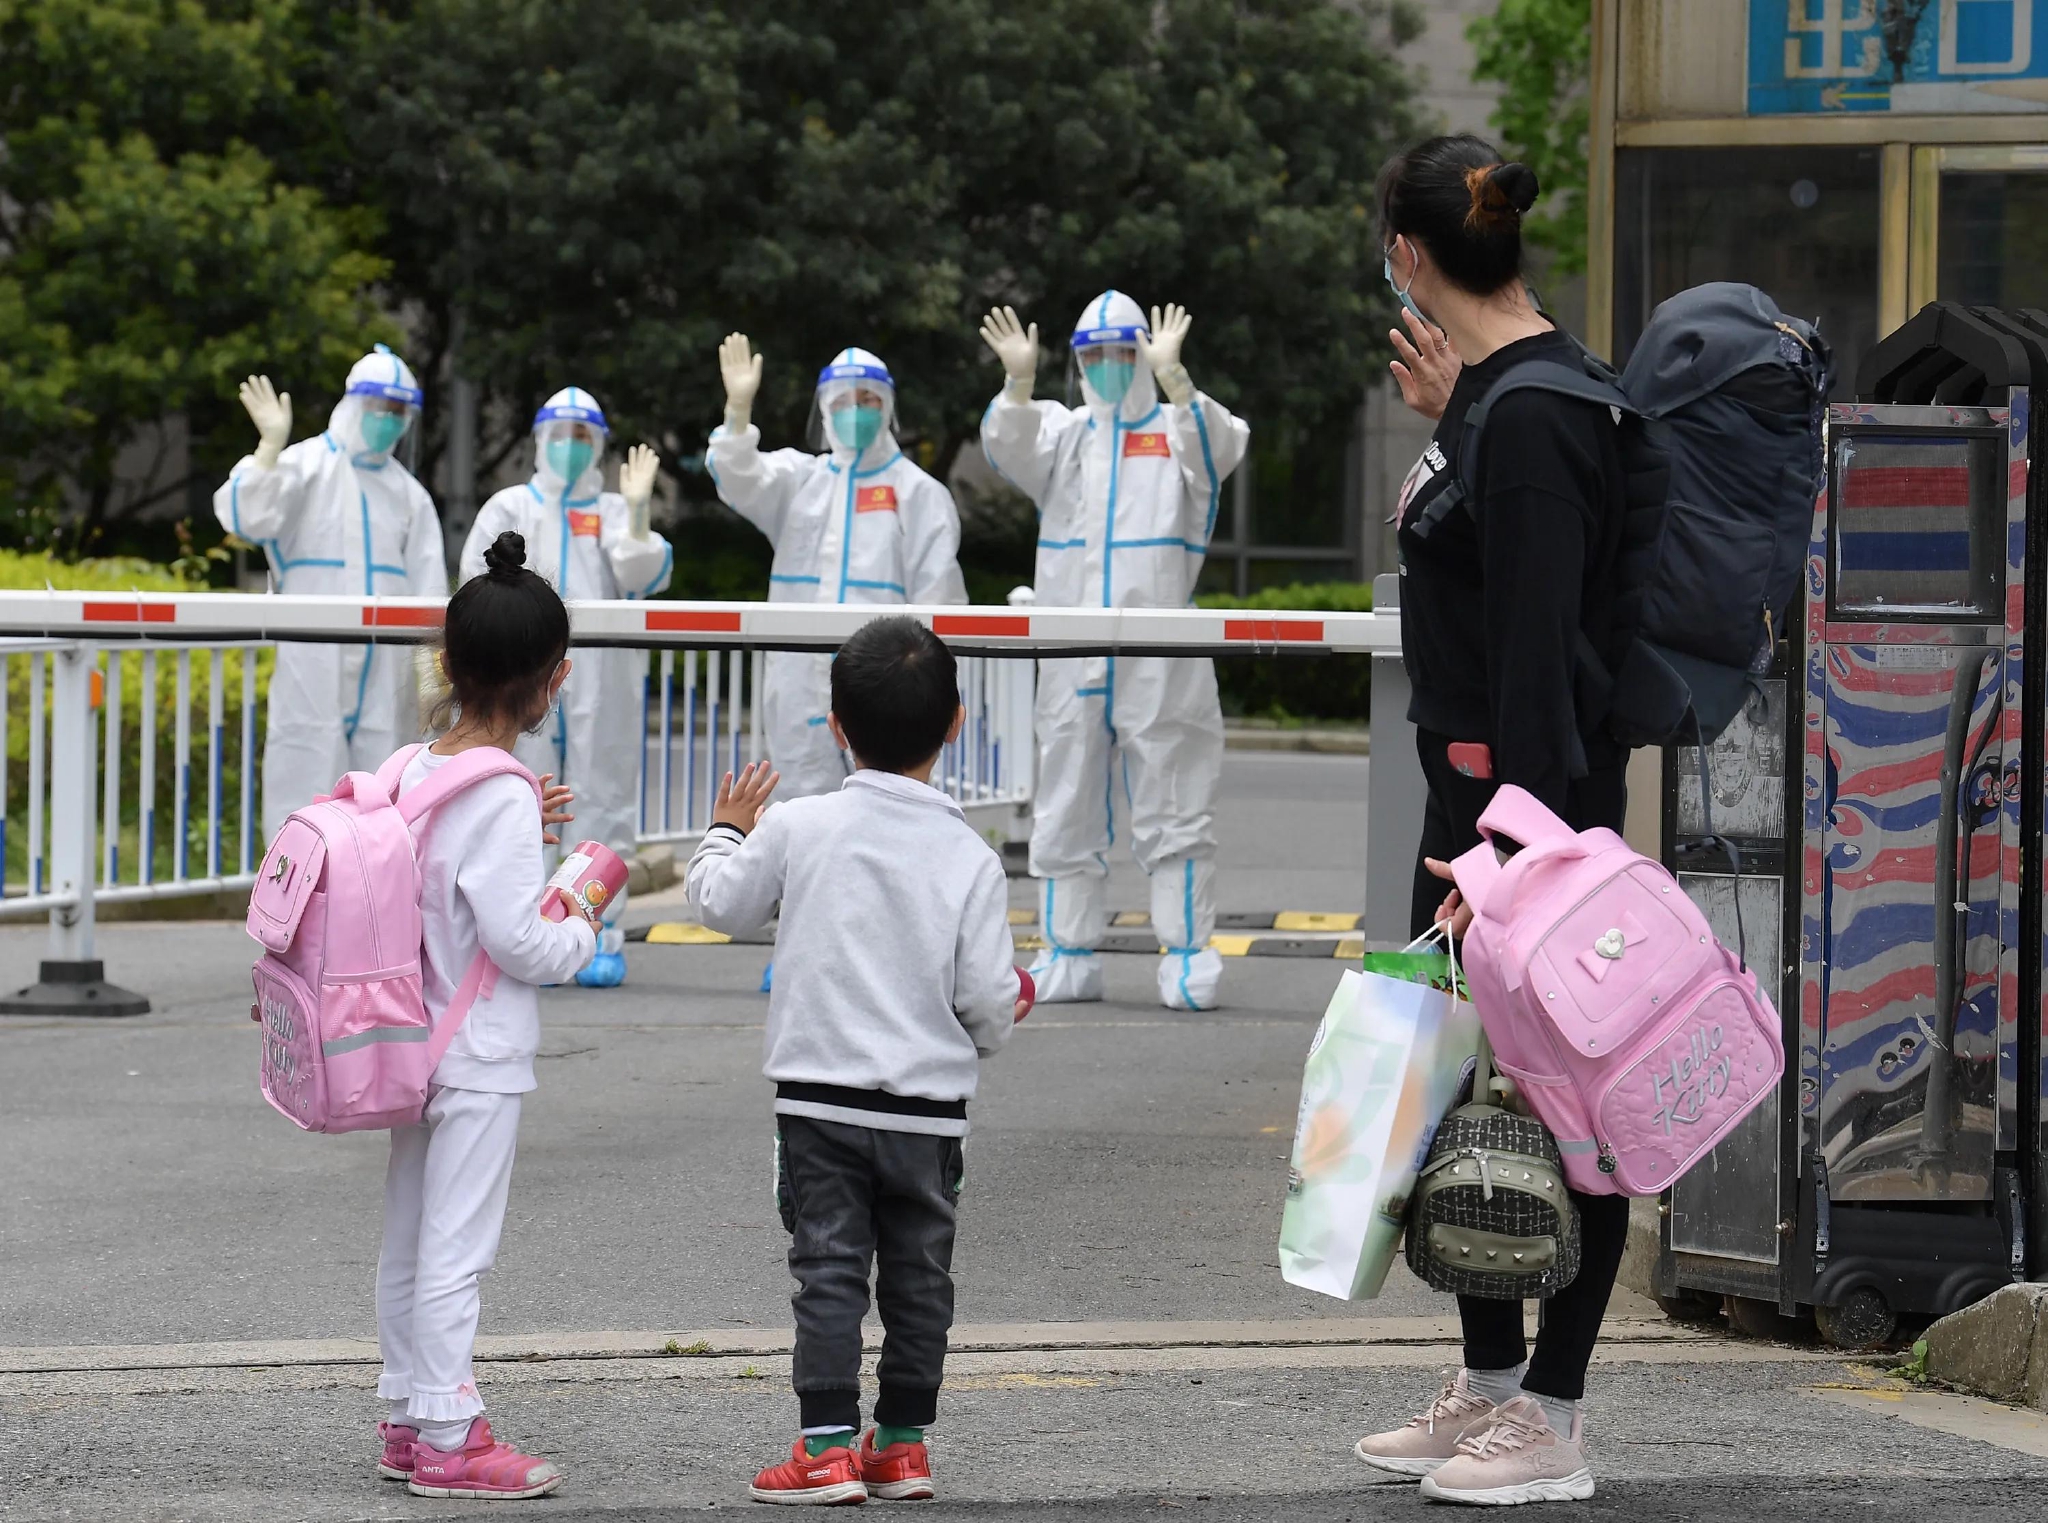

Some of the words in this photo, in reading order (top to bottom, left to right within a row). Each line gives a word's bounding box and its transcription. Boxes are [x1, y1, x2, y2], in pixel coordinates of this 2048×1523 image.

[1784, 0, 2032, 78] 出口
[265, 994, 294, 1043] Hello
[1652, 1024, 1724, 1106] Hello
[1652, 1055, 1731, 1137] Kitty
[421, 1465, 445, 1475] ANTA
